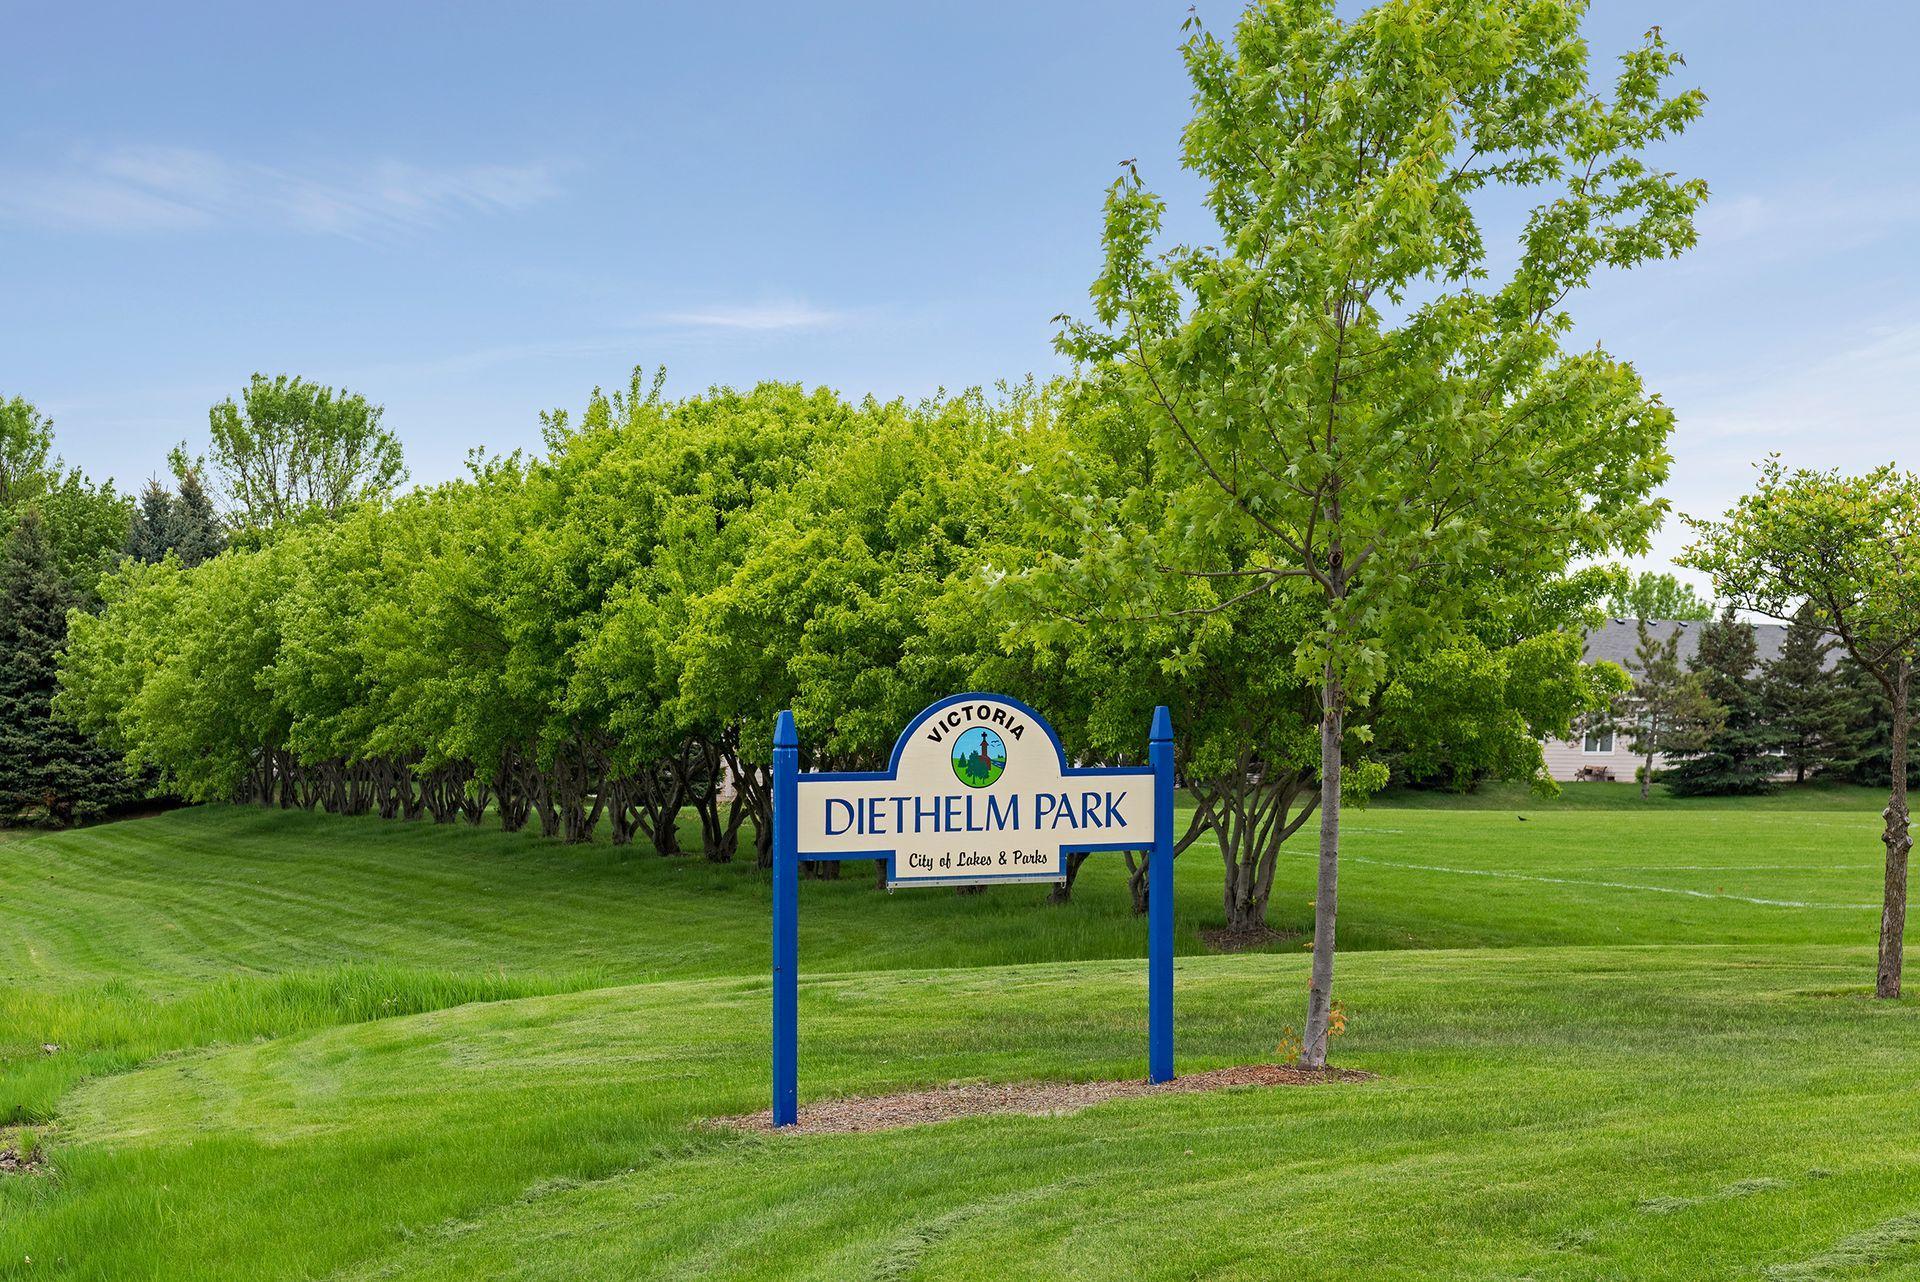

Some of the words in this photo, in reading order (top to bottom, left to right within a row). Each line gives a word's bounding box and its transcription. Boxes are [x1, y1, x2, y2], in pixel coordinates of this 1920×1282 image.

[927, 704, 1025, 743] VICTORIA
[824, 793, 1020, 836] DIETHELM
[1034, 791, 1128, 830] PARK
[909, 852, 934, 872] City
[939, 851, 952, 870] of
[956, 850, 992, 867] Lakes
[998, 850, 1008, 866] &
[1012, 849, 1048, 865] Parks
